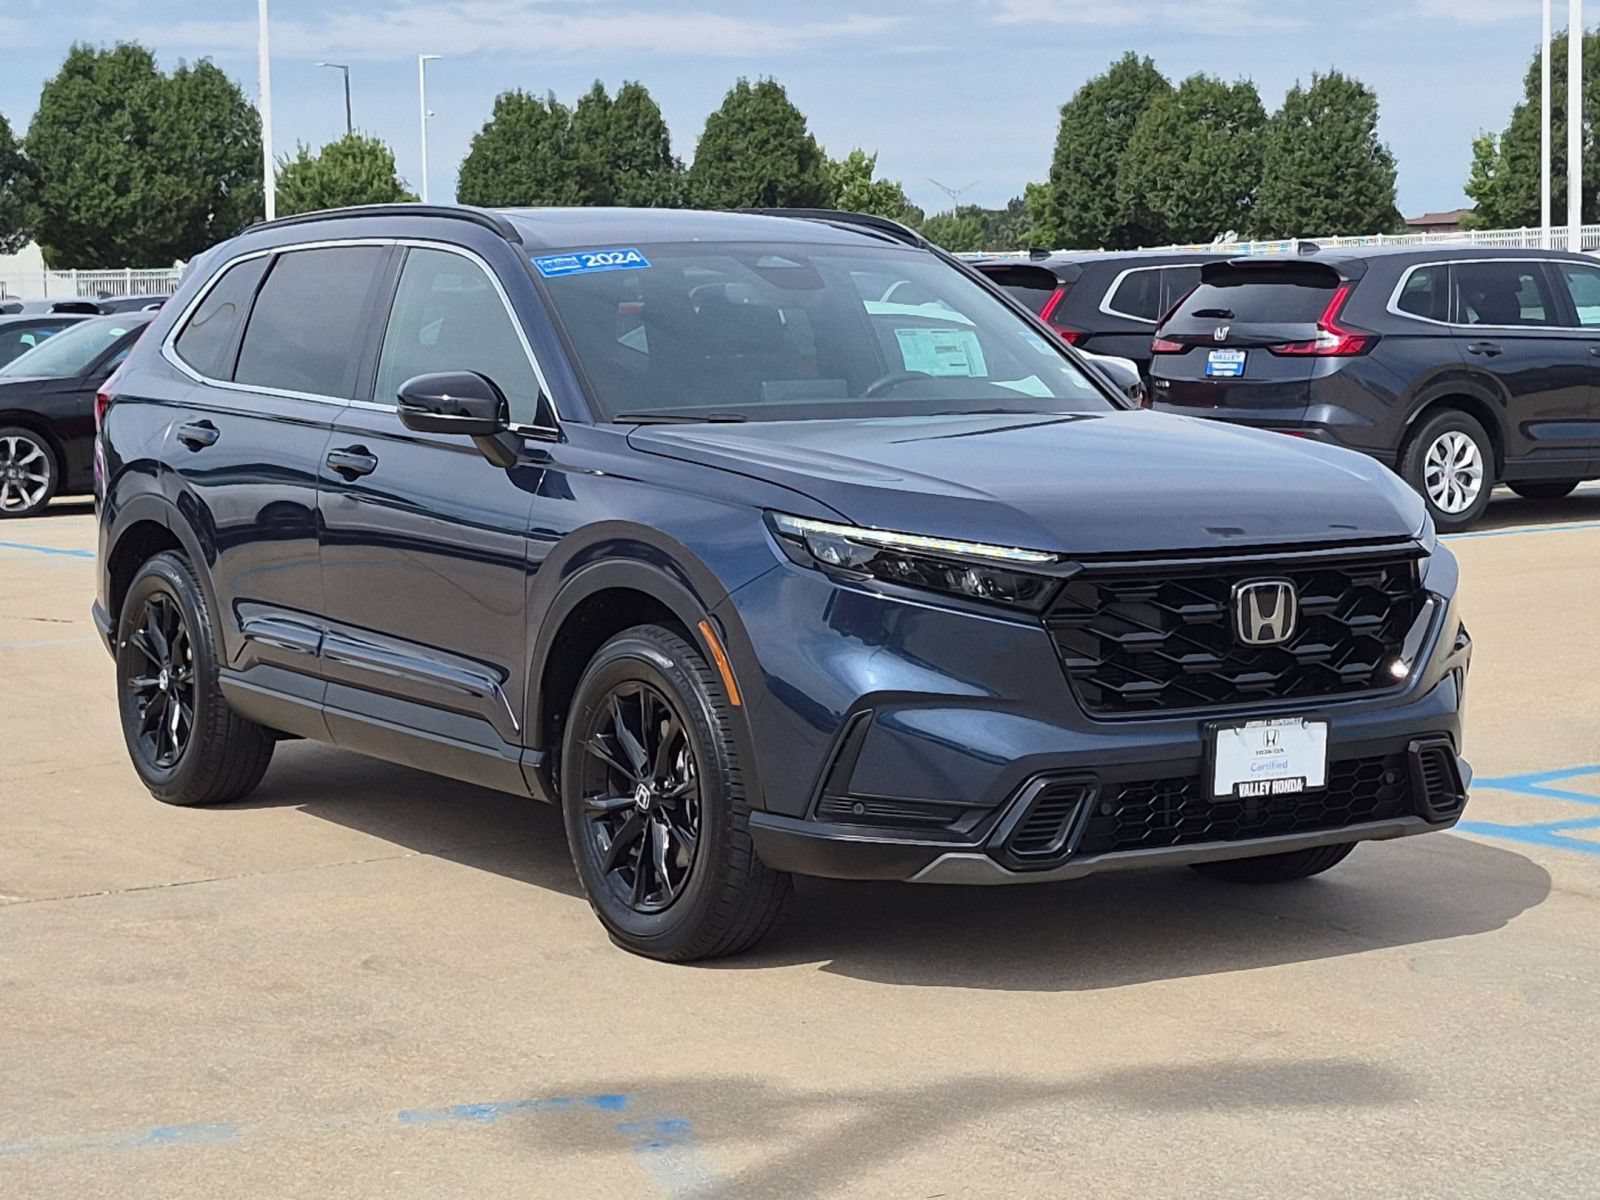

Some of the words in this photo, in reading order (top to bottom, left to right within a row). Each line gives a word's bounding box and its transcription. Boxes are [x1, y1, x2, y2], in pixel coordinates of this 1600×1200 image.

[582, 251, 641, 267] 2024
[1250, 760, 1289, 772] Certified
[1238, 781, 1272, 798] VALLEY
[1272, 778, 1303, 795] HONDA
